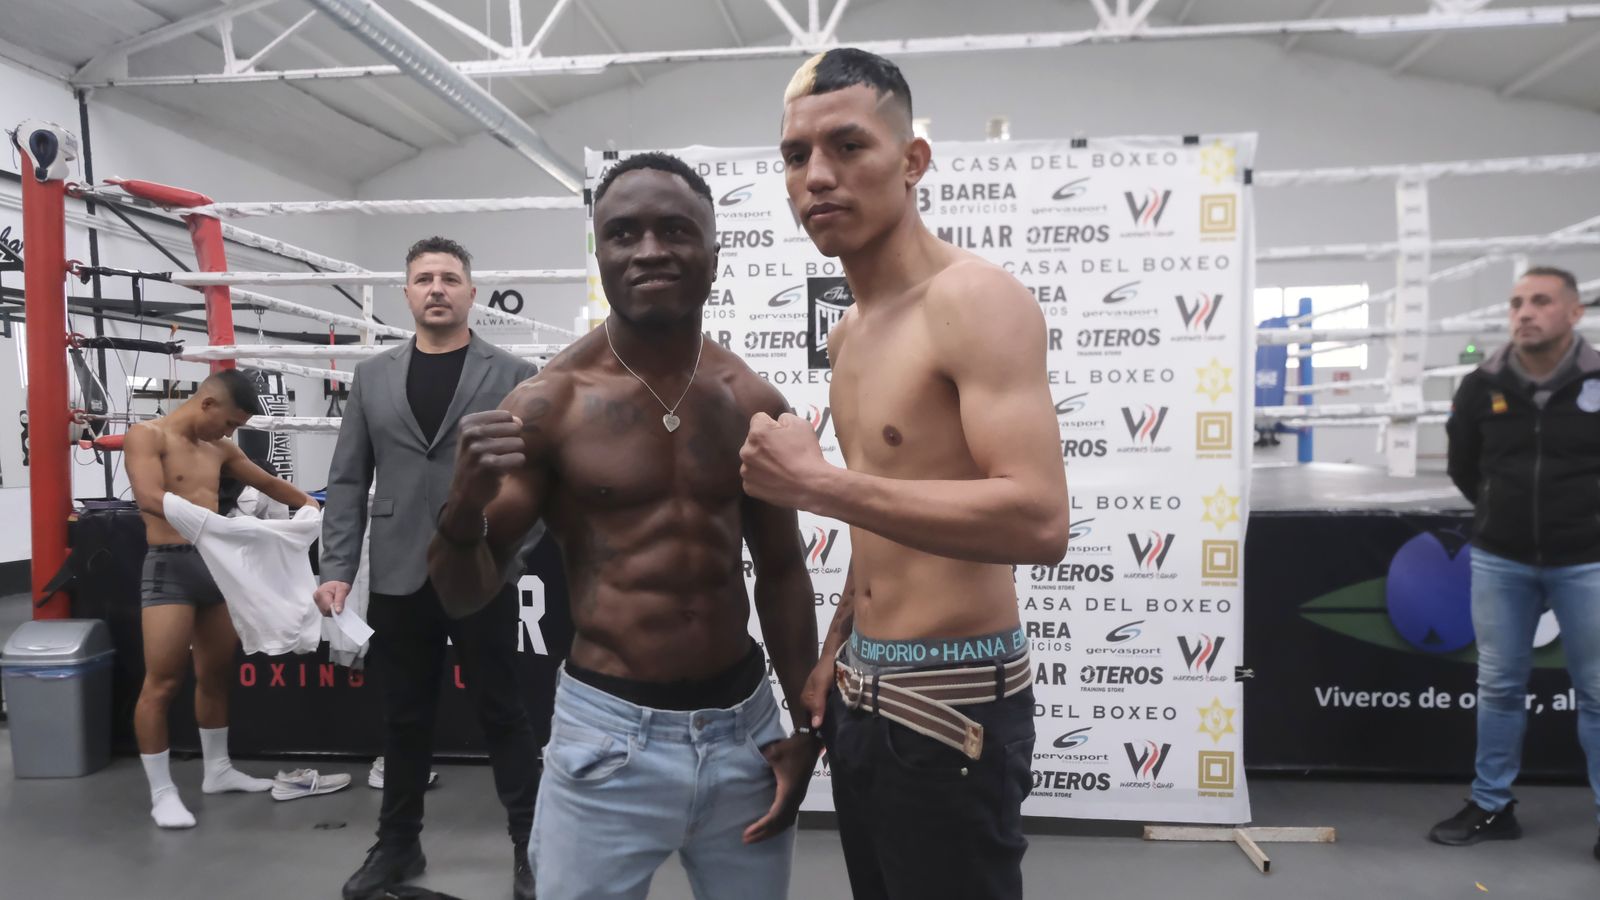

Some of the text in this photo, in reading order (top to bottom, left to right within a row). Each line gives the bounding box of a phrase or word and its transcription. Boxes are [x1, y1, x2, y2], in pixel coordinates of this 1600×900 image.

[699, 160, 743, 176] DEL
[952, 157, 1017, 172] CASA
[1031, 154, 1078, 171] DEL
[1092, 152, 1178, 168] BOXEO
[941, 183, 1016, 201] BAREA
[715, 210, 772, 219] rvasport
[941, 203, 1017, 215] servicios
[716, 229, 774, 248] EROS
[937, 225, 1012, 248] MILAR
[1026, 225, 1110, 244] OTEROS
[748, 263, 792, 277] DEL
[1003, 255, 1230, 275] CASA DEL BOXEO
[749, 311, 808, 320] gervaspo
[744, 330, 808, 350] OTERO
[1077, 328, 1161, 348] OTEROS
[1048, 368, 1175, 384] EL BOXEO
[1097, 496, 1181, 510] BOXEO
[1031, 564, 1114, 582] OTEROS
[1024, 597, 1231, 613] ASA DEL BOXEO
[1027, 621, 1071, 639] REA
[861, 641, 926, 662] EMPORIO
[943, 637, 1006, 661] HANA
[1086, 647, 1161, 656] gervasport
[240, 663, 364, 688] OXING
[1080, 665, 1164, 685] OTEROS
[1315, 686, 1411, 708] Viveros
[1418, 686, 1452, 708] de
[1033, 704, 1177, 720] DEL BOXEO
[1033, 753, 1109, 762] gervasport
